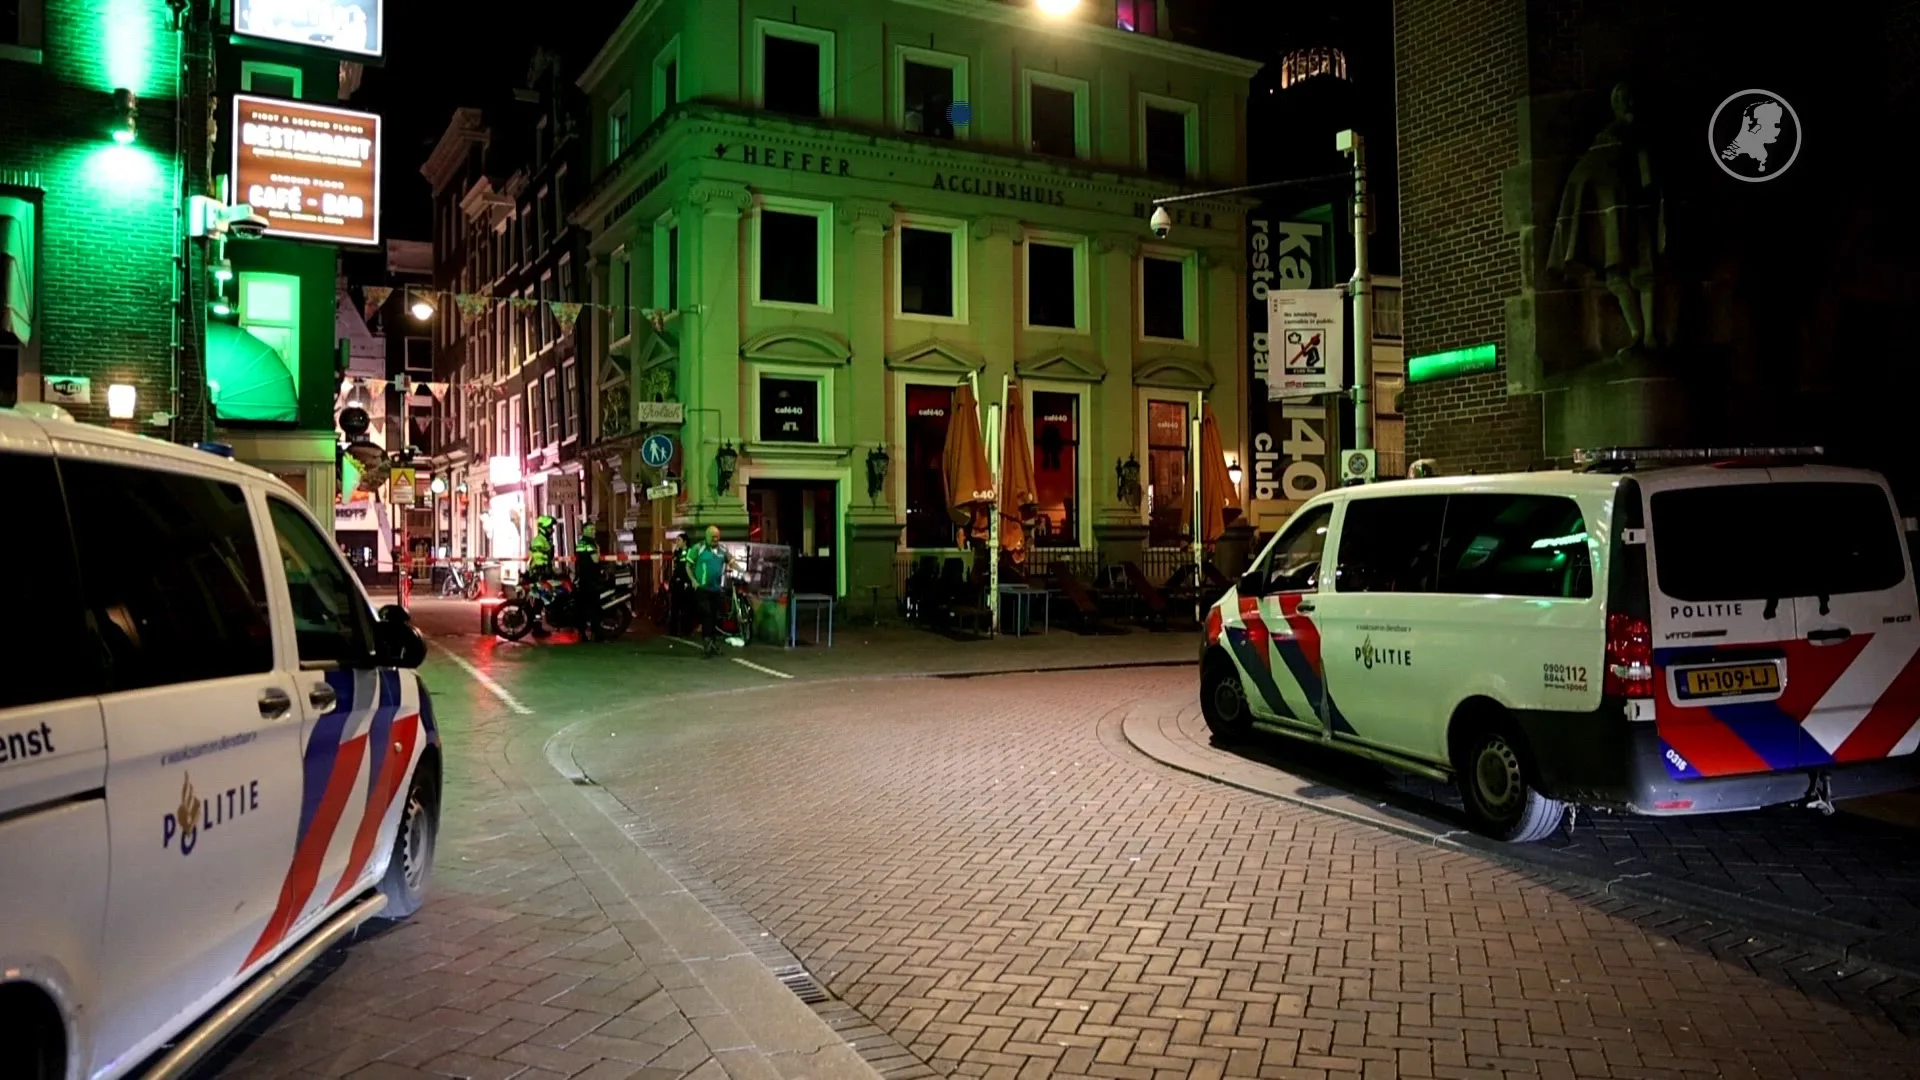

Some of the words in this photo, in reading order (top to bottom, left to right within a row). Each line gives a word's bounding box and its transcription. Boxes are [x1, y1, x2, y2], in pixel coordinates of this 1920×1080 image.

[243, 122, 371, 160] RESTAURANT
[743, 144, 850, 177] HEFFER
[249, 184, 301, 212] CAFÉ
[322, 192, 363, 218] BAR
[933, 171, 1065, 206] ACCIJNSHUIS
[1252, 220, 1274, 300] resto
[1255, 432, 1279, 500] club
[1670, 603, 1742, 619] POLITIE
[1566, 664, 1587, 682] 112
[1697, 668, 1769, 691] H-109-LJ
